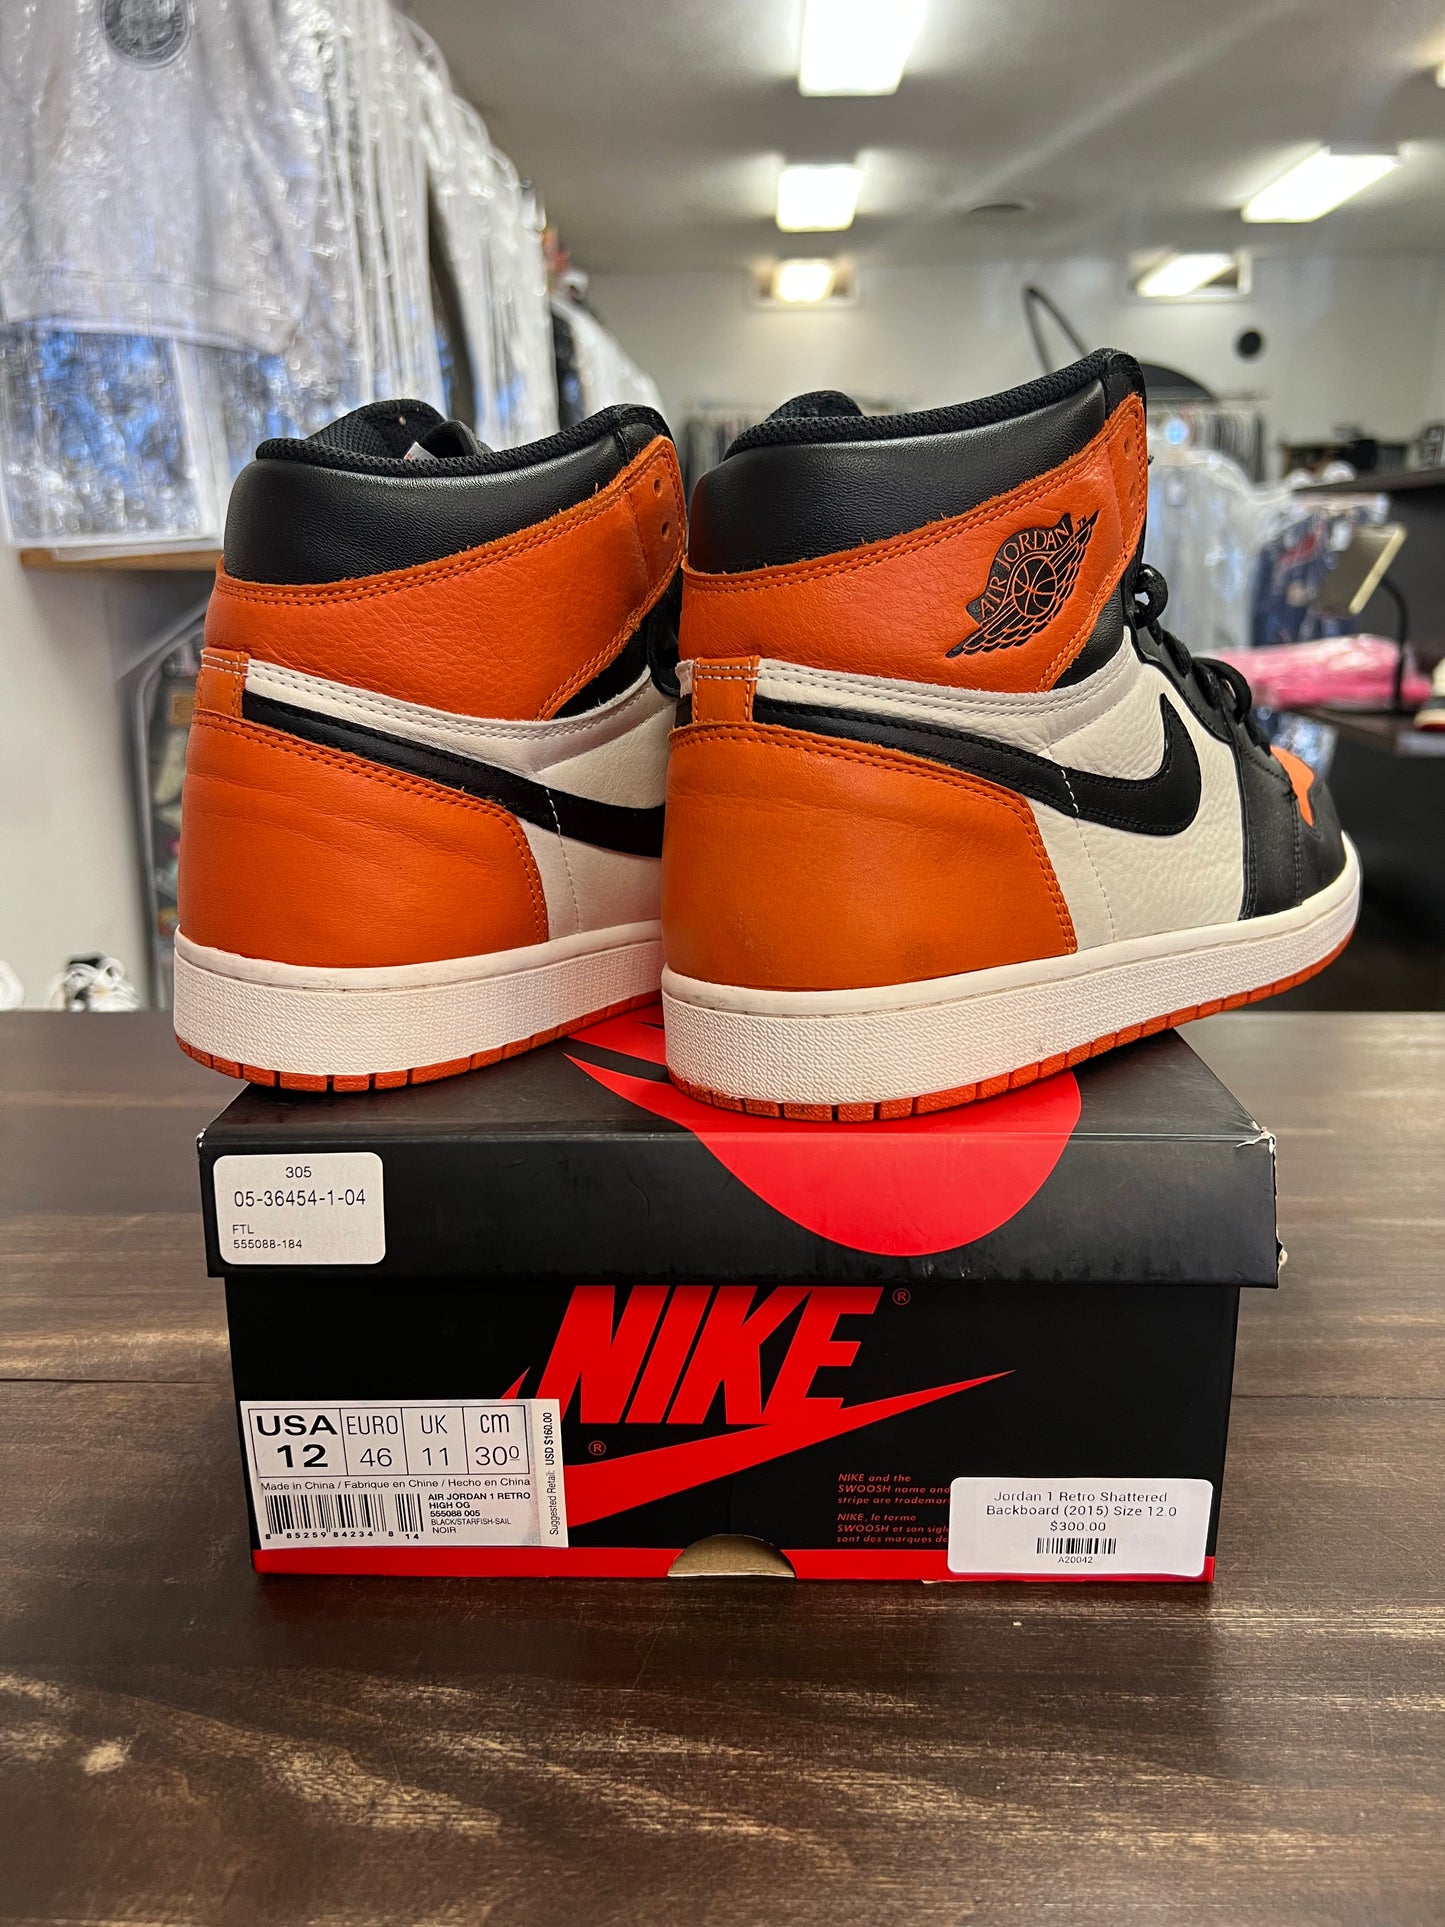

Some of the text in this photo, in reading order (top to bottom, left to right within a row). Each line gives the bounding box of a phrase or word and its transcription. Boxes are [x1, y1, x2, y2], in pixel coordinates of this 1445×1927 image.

[979, 576, 1008, 619] AIR
[995, 521, 1071, 571] JORDAN
[285, 1166, 313, 1179] 305
[233, 1188, 367, 1208] 05-36454-1-04
[232, 1224, 255, 1235] FTL
[233, 1239, 303, 1250] 555088-184
[536, 1285, 885, 1424] NIKE
[256, 1413, 511, 1437] USA EURO UK cm
[542, 1411, 554, 1446] $160.00
[276, 1443, 329, 1468] 12
[359, 1447, 393, 1468] 46
[422, 1447, 449, 1467] 11
[544, 1446, 555, 1466] USD
[838, 1473, 912, 1482] NIKE and the
[261, 1481, 290, 1491] Made
[292, 1480, 302, 1490] in
[304, 1480, 335, 1490] China
[344, 1479, 390, 1490] Fabrique
[392, 1481, 406, 1489] en
[408, 1478, 439, 1488] Chine
[448, 1478, 482, 1488] Hecho
[484, 1479, 498, 1487] en
[500, 1477, 531, 1487] China
[838, 1484, 892, 1493] SWOOSH
[428, 1493, 445, 1501] AIR
[446, 1492, 487, 1501] JORDAN
[497, 1492, 531, 1500] RETRO
[837, 1496, 870, 1505] stripe
[894, 1496, 951, 1505] trademar
[993, 1491, 1042, 1502] Jordan
[1059, 1491, 1096, 1502] Retro
[1100, 1491, 1168, 1503] Shattered
[455, 1501, 471, 1509] OG
[430, 1509, 481, 1518] 555088 005
[549, 1495, 561, 1536] Suggested
[986, 1504, 1178, 1518] Backboard (2015) Size 12.0
[431, 1517, 512, 1526] BLACK/STARFISH-SAIL
[871, 1513, 881, 1521] le
[883, 1514, 917, 1522] terme
[432, 1526, 457, 1534] NOIR
[837, 1524, 890, 1533] SWOOSH
[892, 1525, 903, 1533] et
[1050, 1520, 1107, 1533] $300.00
[286, 1531, 327, 1539] 85259
[333, 1531, 374, 1539] 84234
[836, 1535, 860, 1543] sont
[863, 1535, 882, 1543] des
[884, 1536, 932, 1545] marques
[1057, 1555, 1094, 1564] A20042
